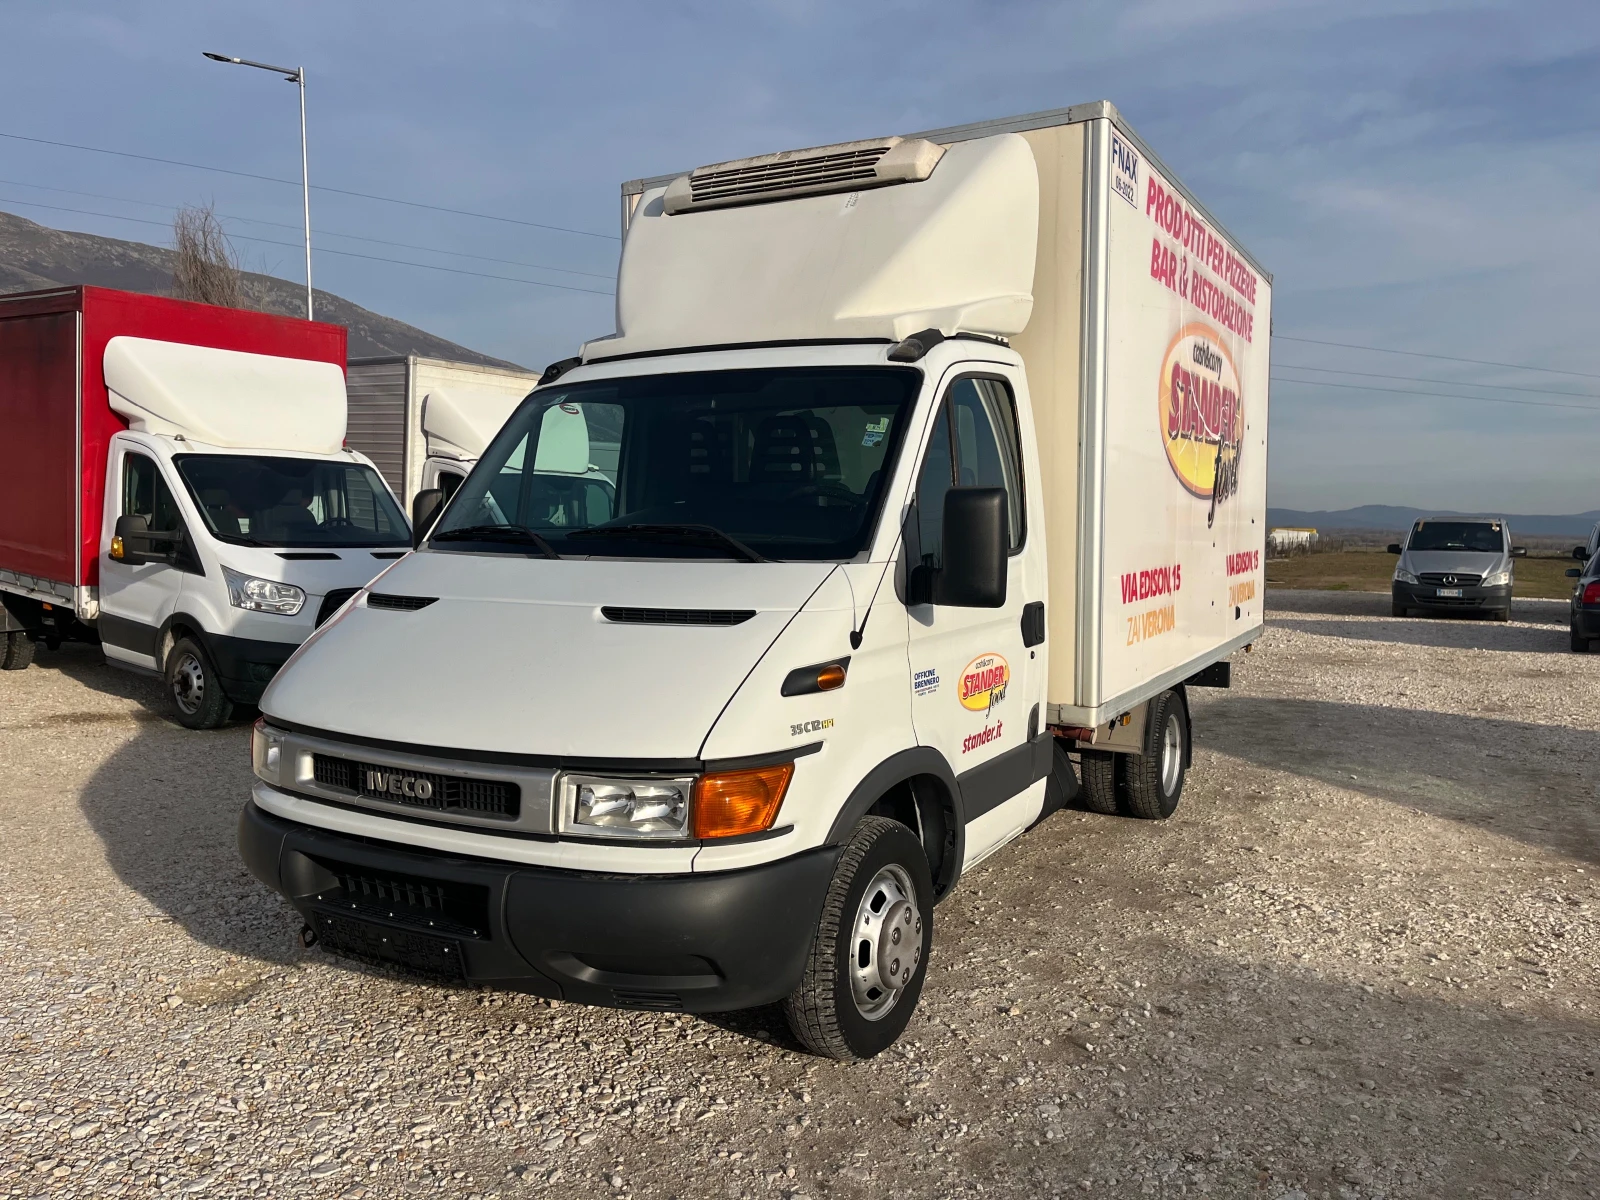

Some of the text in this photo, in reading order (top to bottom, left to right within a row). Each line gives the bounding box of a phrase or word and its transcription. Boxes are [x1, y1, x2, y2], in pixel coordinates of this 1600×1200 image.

[1112, 137, 1138, 184] FNAX
[1146, 175, 1257, 306] PRODOTTI PER PIZZERIE
[1151, 238, 1254, 344] BAR & RISTORAZIONE
[1168, 361, 1238, 449] STANDER
[1226, 554, 1235, 577] VIA
[1253, 549, 1259, 570] 15
[1121, 564, 1181, 605] VIA EDISON, 15
[1126, 605, 1175, 647] ZAI VERONA
[914, 669, 936, 681] OFFICINE
[914, 676, 940, 690] BRENNERO
[963, 665, 1004, 700] STANDER
[962, 719, 1003, 754] stander.it
[366, 771, 433, 799] IVECO
